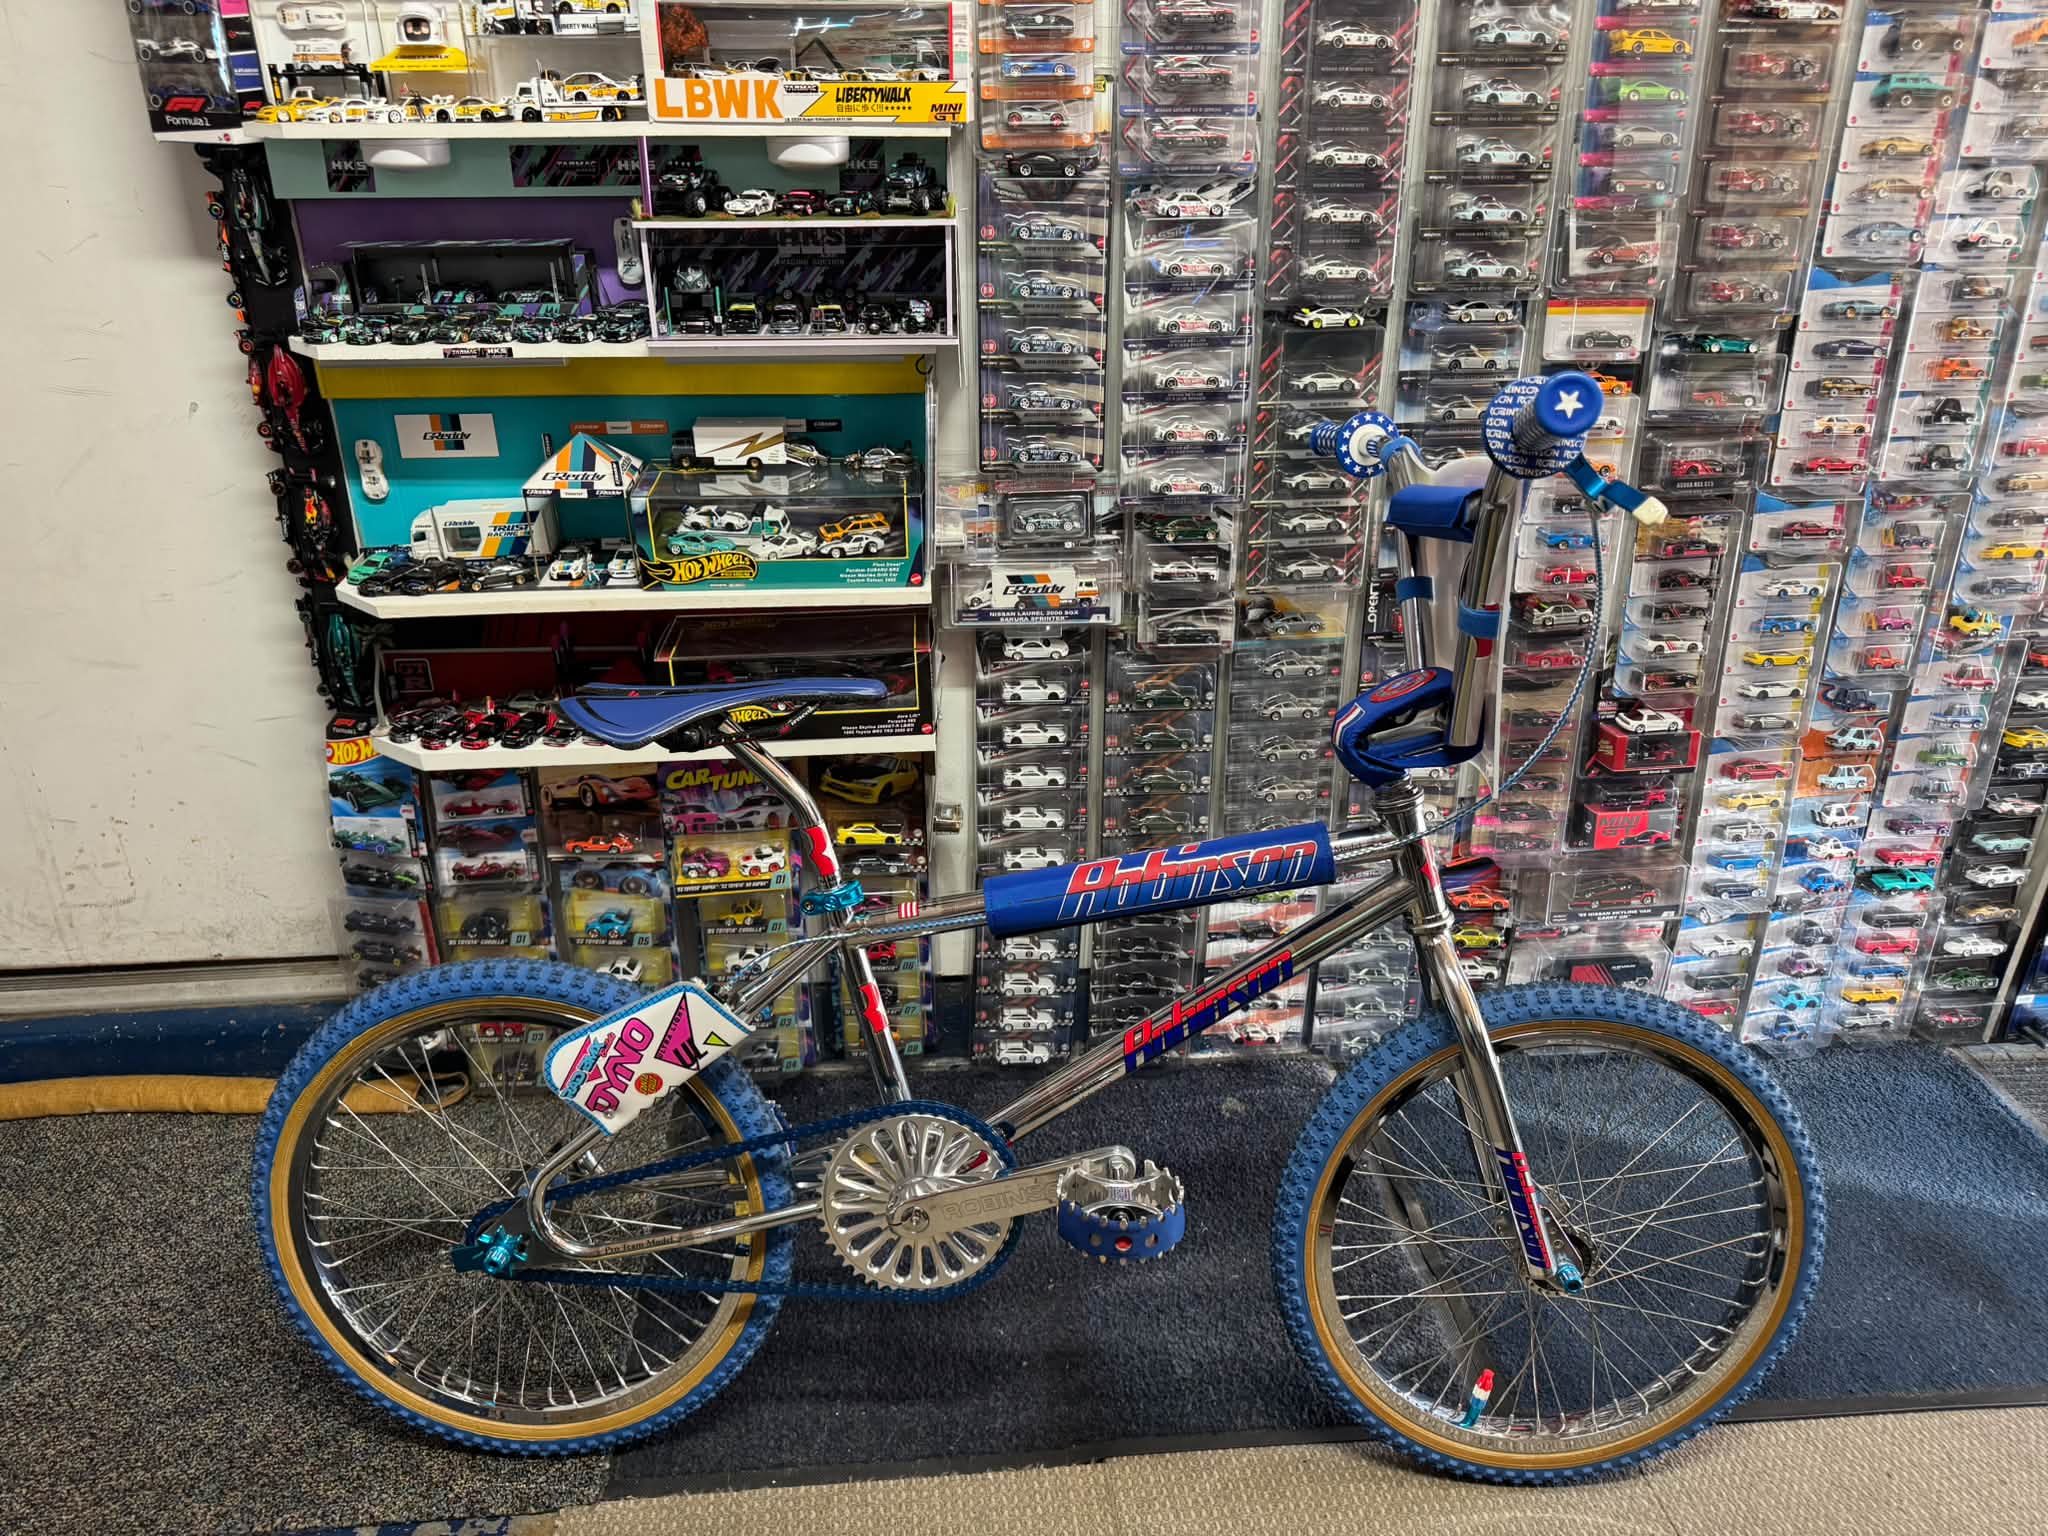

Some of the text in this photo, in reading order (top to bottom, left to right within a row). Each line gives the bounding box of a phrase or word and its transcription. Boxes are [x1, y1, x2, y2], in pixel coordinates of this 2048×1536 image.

[654, 78, 784, 119] LBWK
[930, 103, 963, 112] MINI
[934, 112, 961, 121] GT
[331, 161, 368, 170] HKS
[423, 431, 472, 440] GReddy
[542, 472, 606, 481] GReddy
[1003, 584, 1066, 596] GReddy
[333, 739, 360, 766] HOT
[1600, 815, 1642, 827] MINI
[1602, 825, 1637, 837] GT
[1057, 841, 1318, 920] Robinson
[515, 934, 527, 944] 01
[1123, 950, 1293, 1073] Robinson
[585, 1017, 655, 1112] DYNO
[943, 1181, 1057, 1220] ROBINSO
[1496, 1148, 1552, 1270] Robinson
[605, 1245, 620, 1255] Pro
